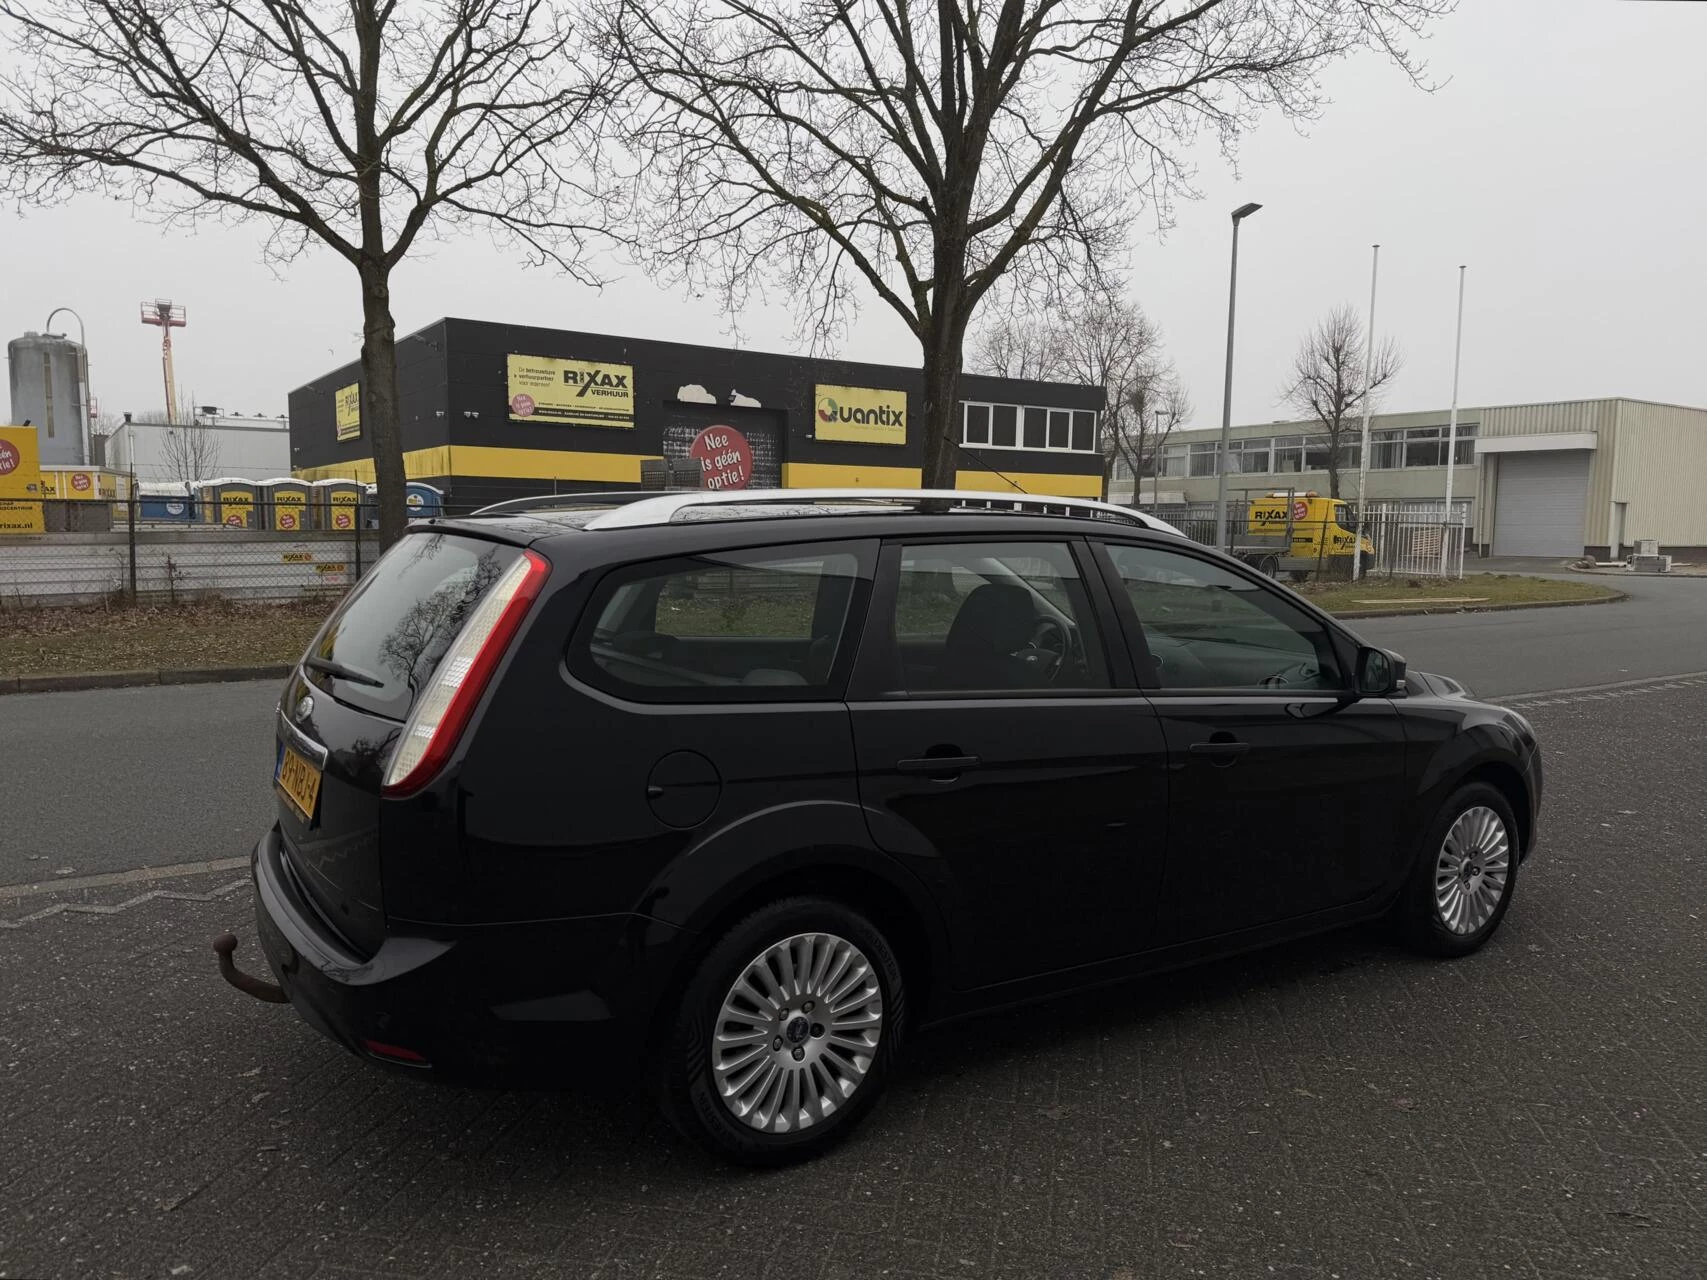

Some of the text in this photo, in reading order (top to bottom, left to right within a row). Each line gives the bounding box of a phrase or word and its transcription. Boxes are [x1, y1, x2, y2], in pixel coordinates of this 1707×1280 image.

[590, 388, 629, 399] VERHUUR
[704, 433, 729, 451] Nee
[700, 448, 741, 472] is géén
[707, 465, 745, 489] optie!
